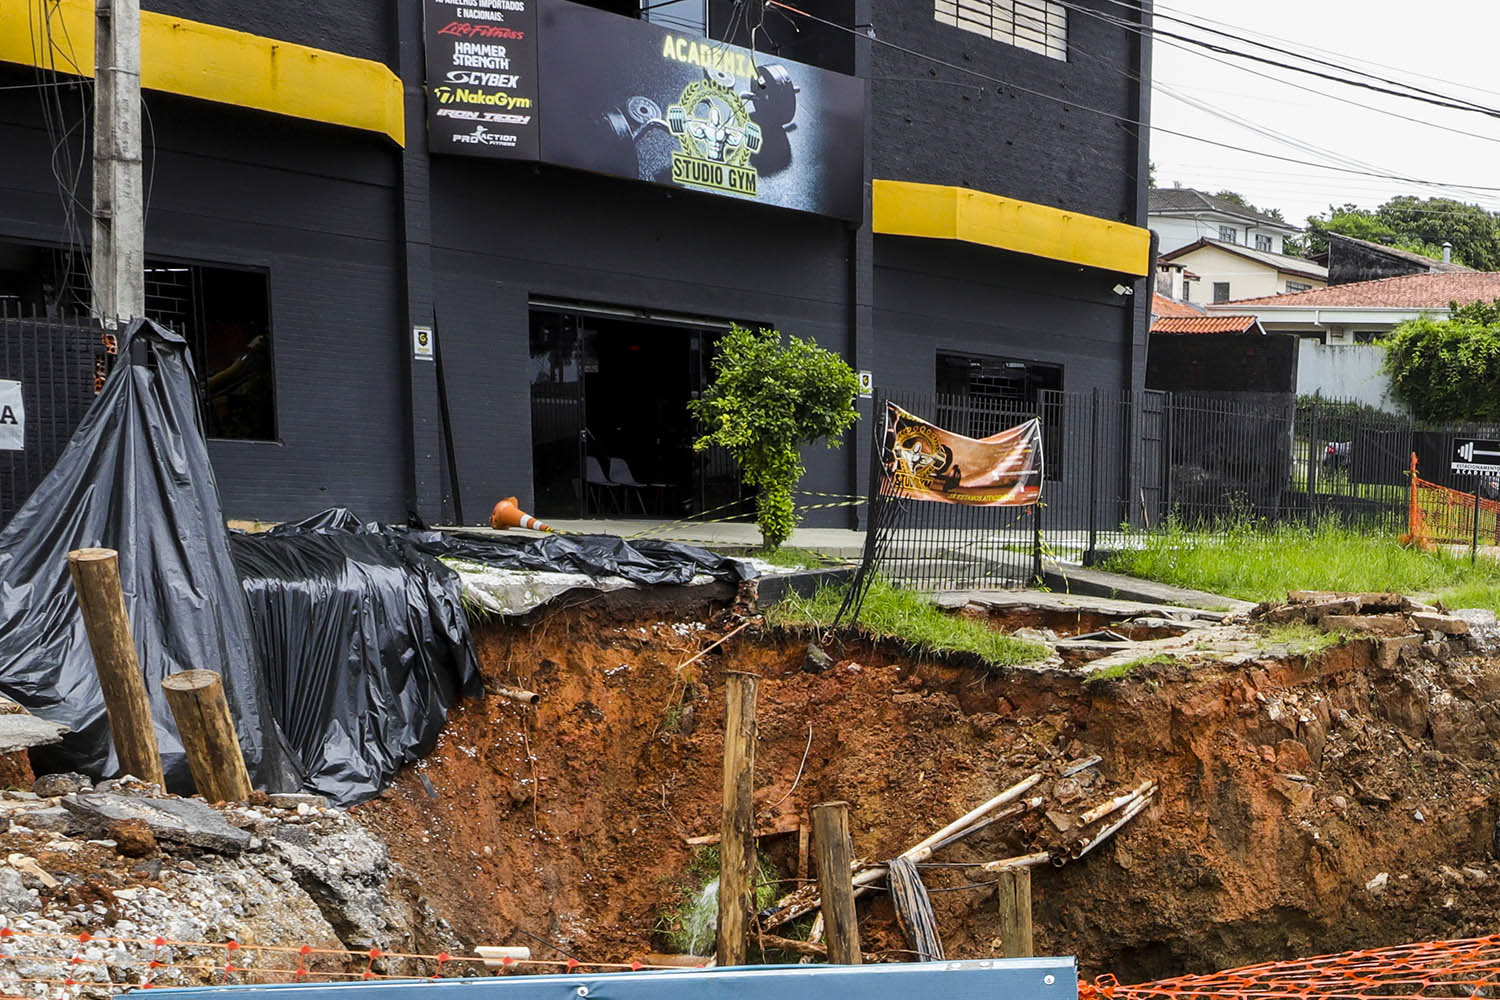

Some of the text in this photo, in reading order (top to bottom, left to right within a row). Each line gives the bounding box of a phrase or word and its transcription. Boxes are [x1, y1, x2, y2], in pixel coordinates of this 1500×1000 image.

[457, 8, 462, 18] E
[454, 41, 506, 58] HAMMER
[663, 35, 759, 81] ACADEMIA
[452, 54, 511, 70] STRENGTH
[469, 71, 519, 88] CYBEX
[455, 88, 530, 110] NakaGym
[673, 158, 756, 192] STUDIO GYM
[1456, 469, 1500, 477] ACADEMIA
